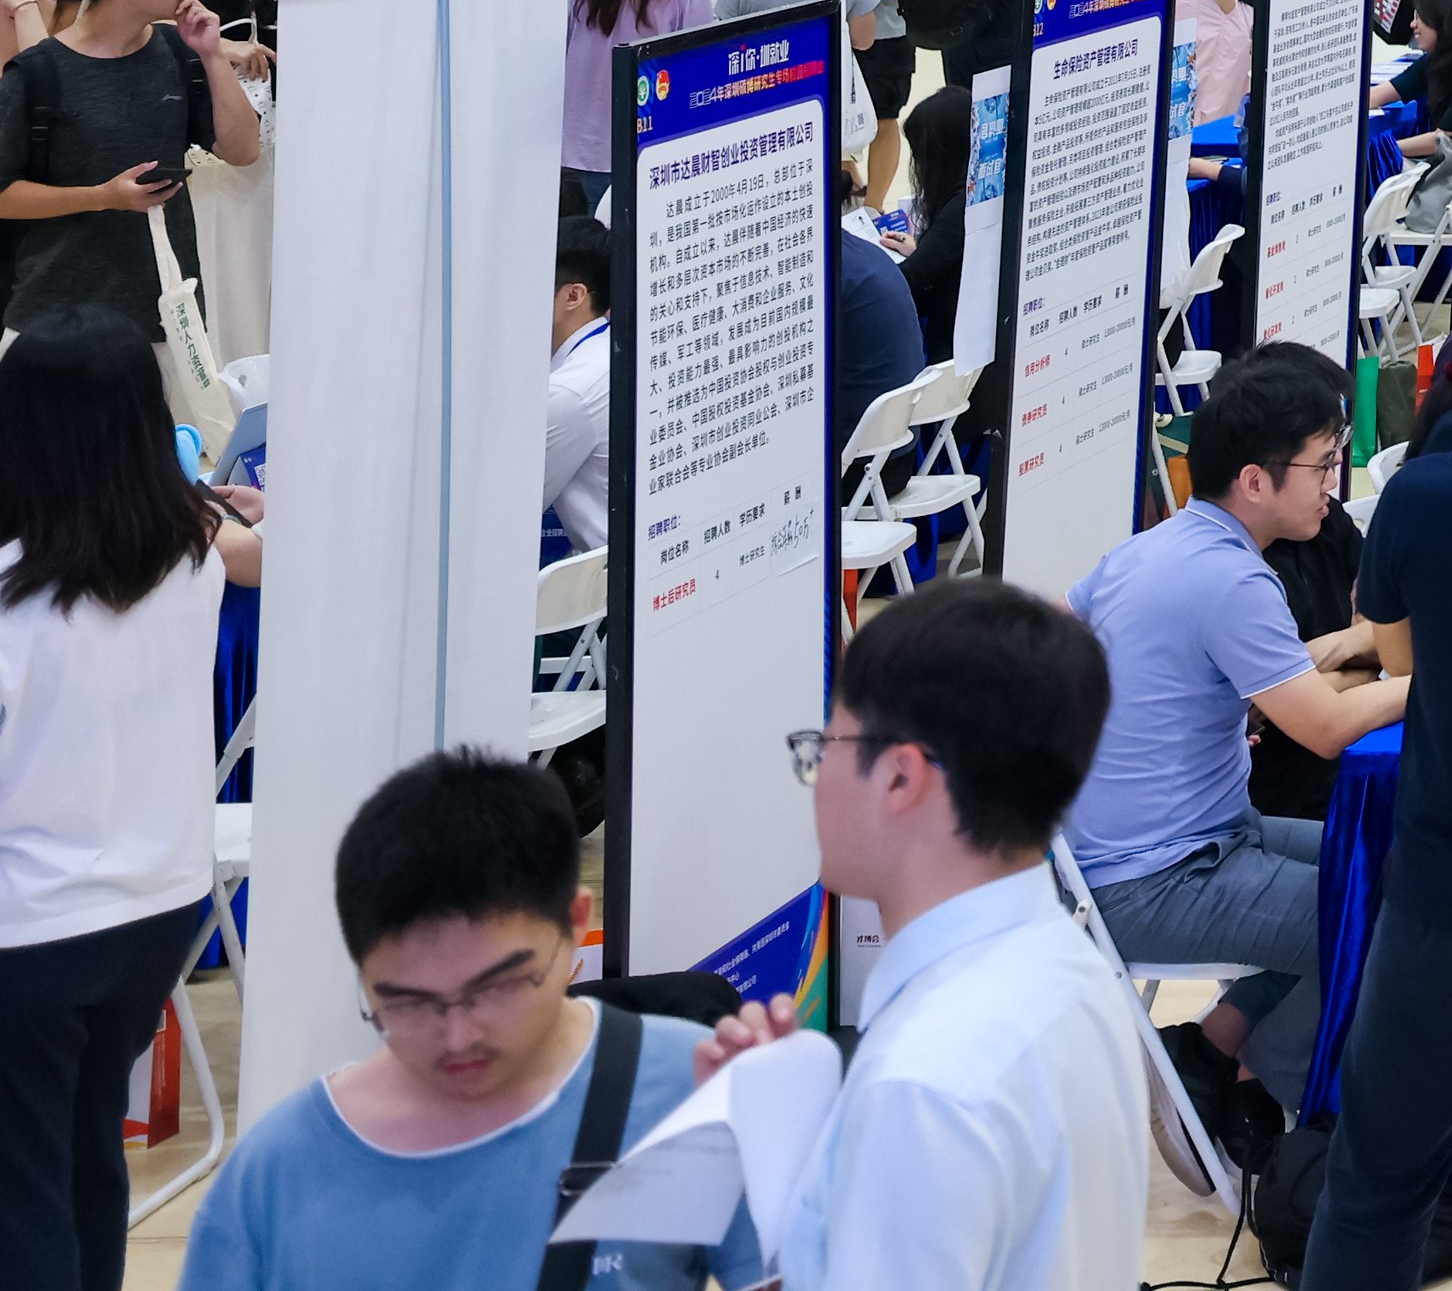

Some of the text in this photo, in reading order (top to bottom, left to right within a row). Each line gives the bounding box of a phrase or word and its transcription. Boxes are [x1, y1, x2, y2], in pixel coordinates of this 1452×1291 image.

[1053, 38, 1139, 80] 生命保险资产管理有限公司
[649, 121, 814, 190] 深圳市达晨财智创业投资管理有限公司
[666, 158, 813, 219] 达晨成立于2000年4月19日，总部位于深
[660, 539, 690, 565] 岗位名称
[704, 520, 731, 545] 招聘人数
[739, 503, 765, 527] 学历要求
[653, 578, 696, 612] 博士后研究员
[739, 545, 765, 567] 博士研究生
